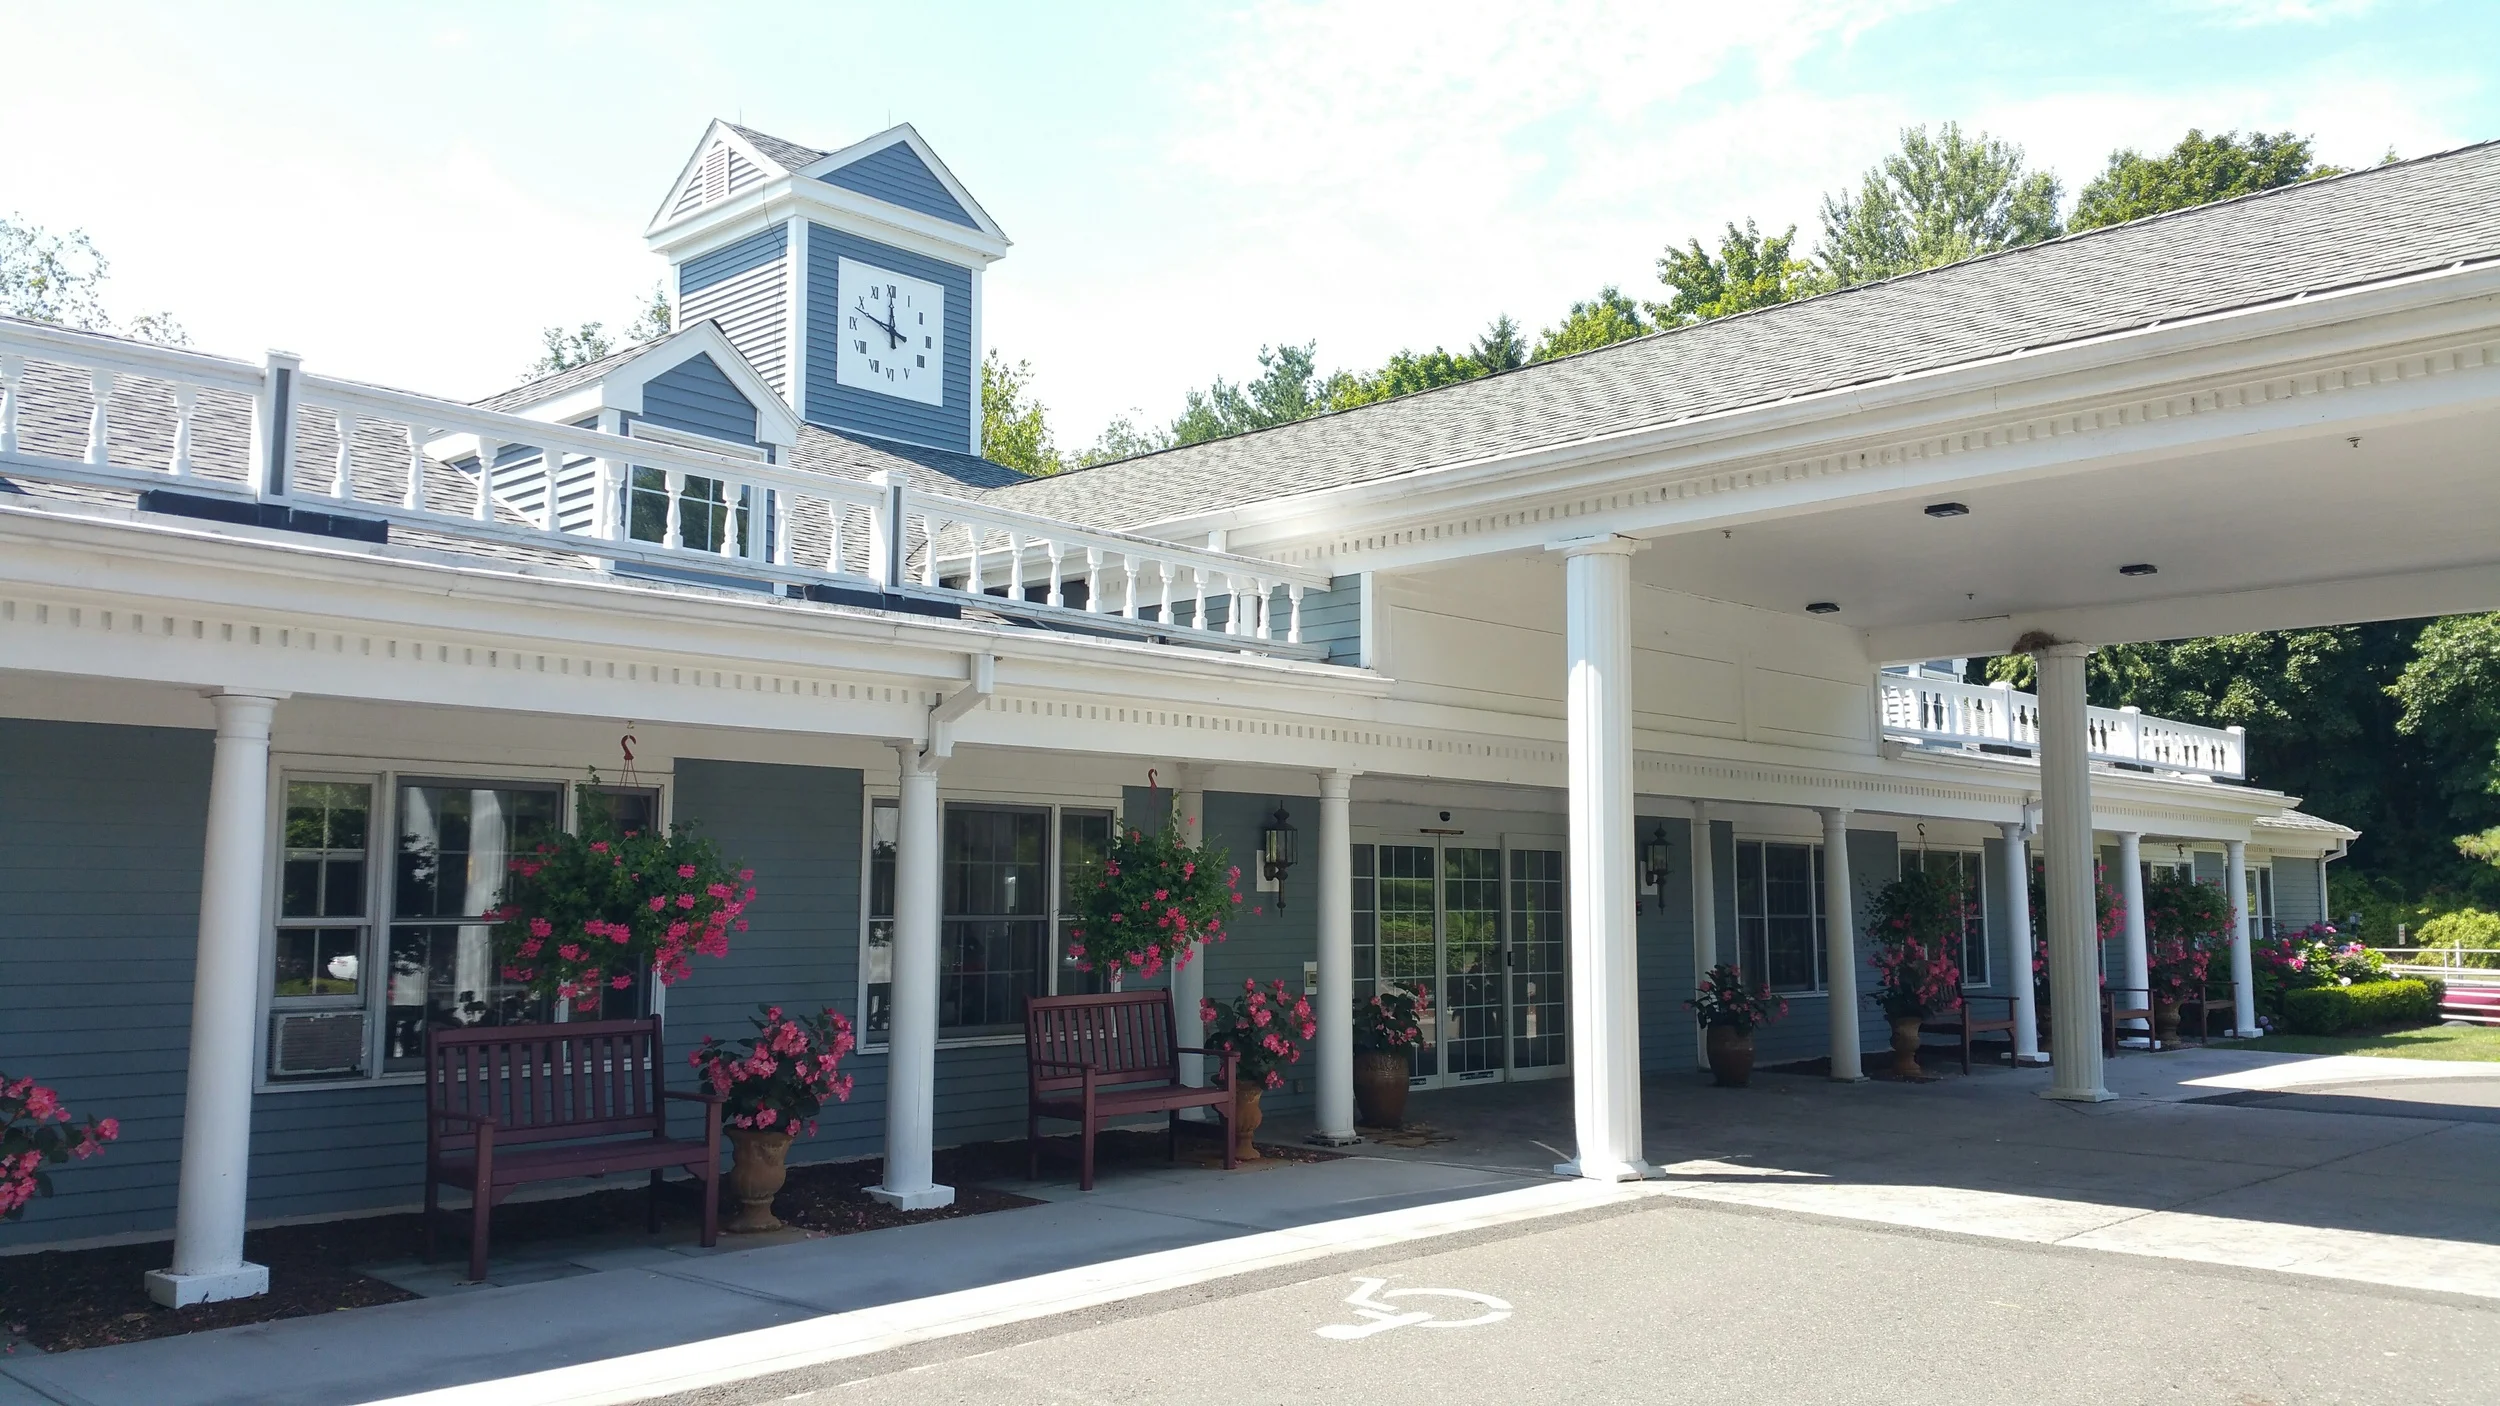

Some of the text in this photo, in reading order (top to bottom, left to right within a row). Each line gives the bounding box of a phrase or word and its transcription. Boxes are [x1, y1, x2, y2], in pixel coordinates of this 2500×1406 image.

[871, 286, 878, 300] XI
[887, 284, 896, 298] XII
[858, 296, 865, 310] X
[849, 316, 857, 330] IX
[918, 312, 924, 325] II
[854, 339, 867, 355] VIII
[869, 359, 879, 373] VII
[886, 367, 894, 382] VI
[904, 368, 910, 380] V
